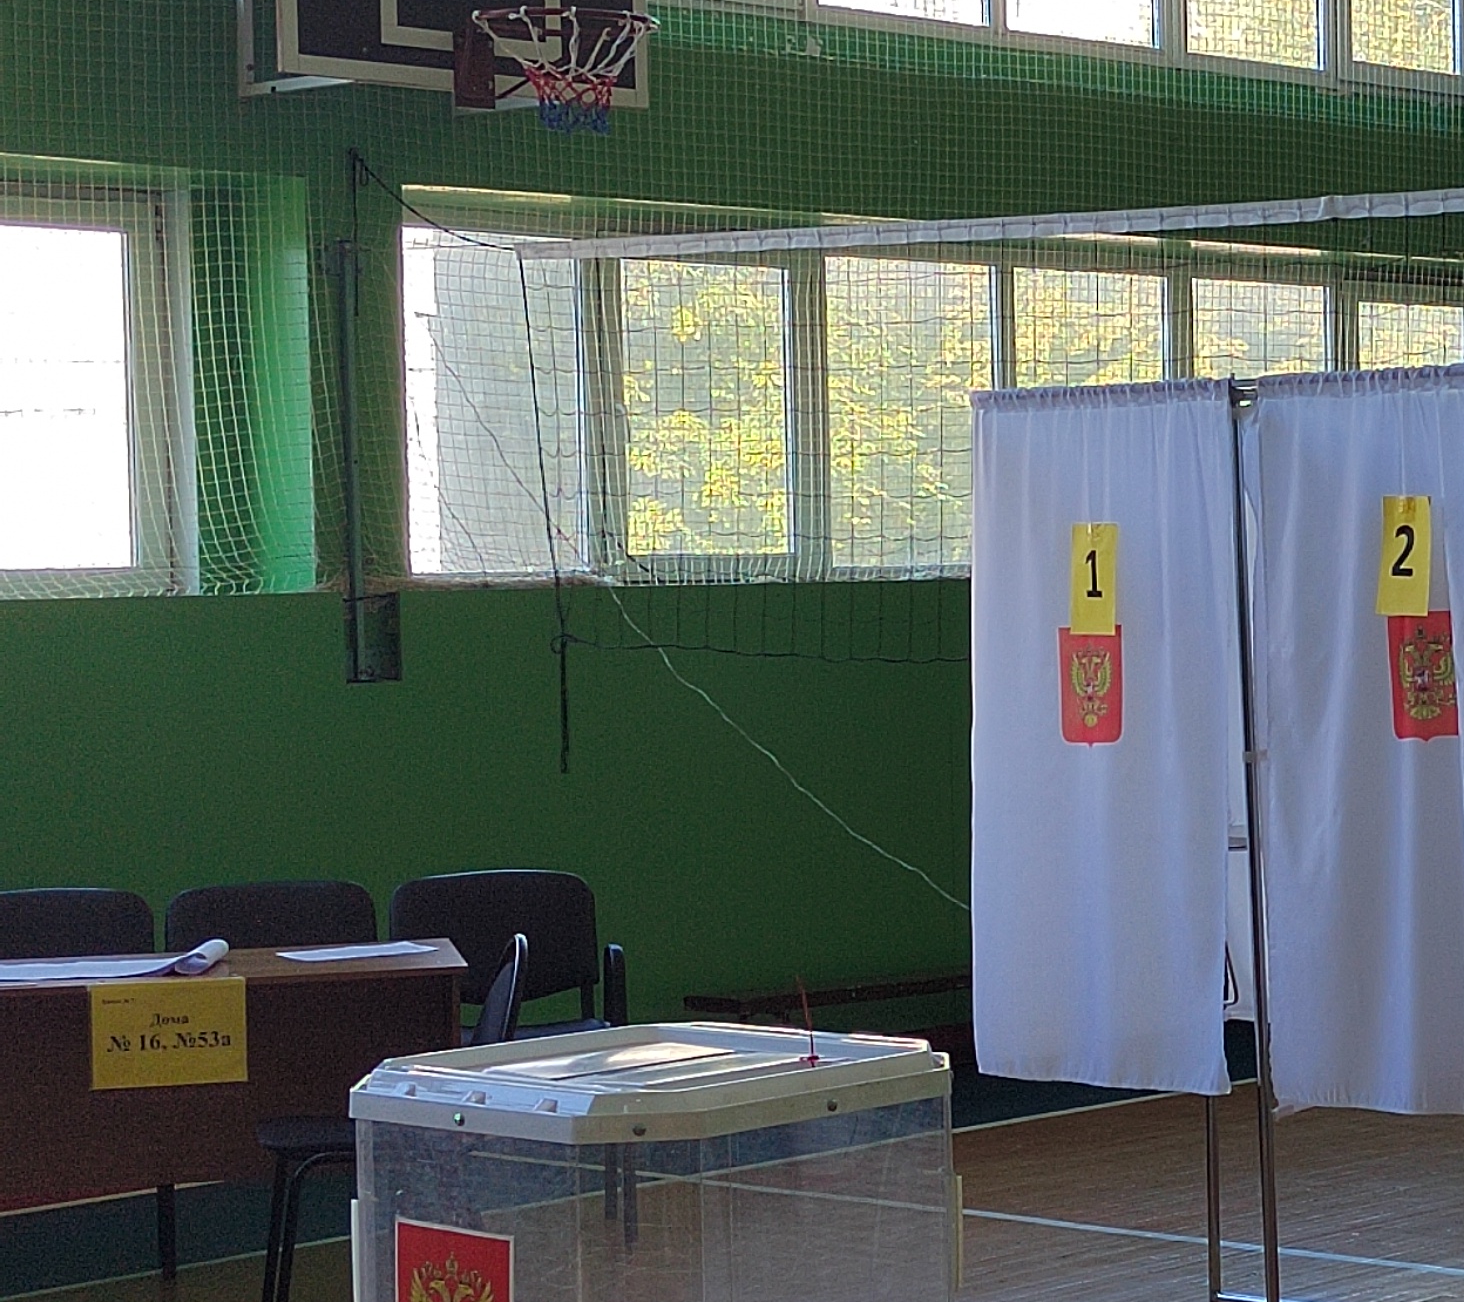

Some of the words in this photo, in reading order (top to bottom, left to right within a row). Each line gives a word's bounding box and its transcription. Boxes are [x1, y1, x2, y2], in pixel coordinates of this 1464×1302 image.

[1391, 524, 1415, 577] 2
[1085, 549, 1103, 598] 1
[150, 1013, 189, 1028] Дома
[107, 1035, 131, 1052] №
